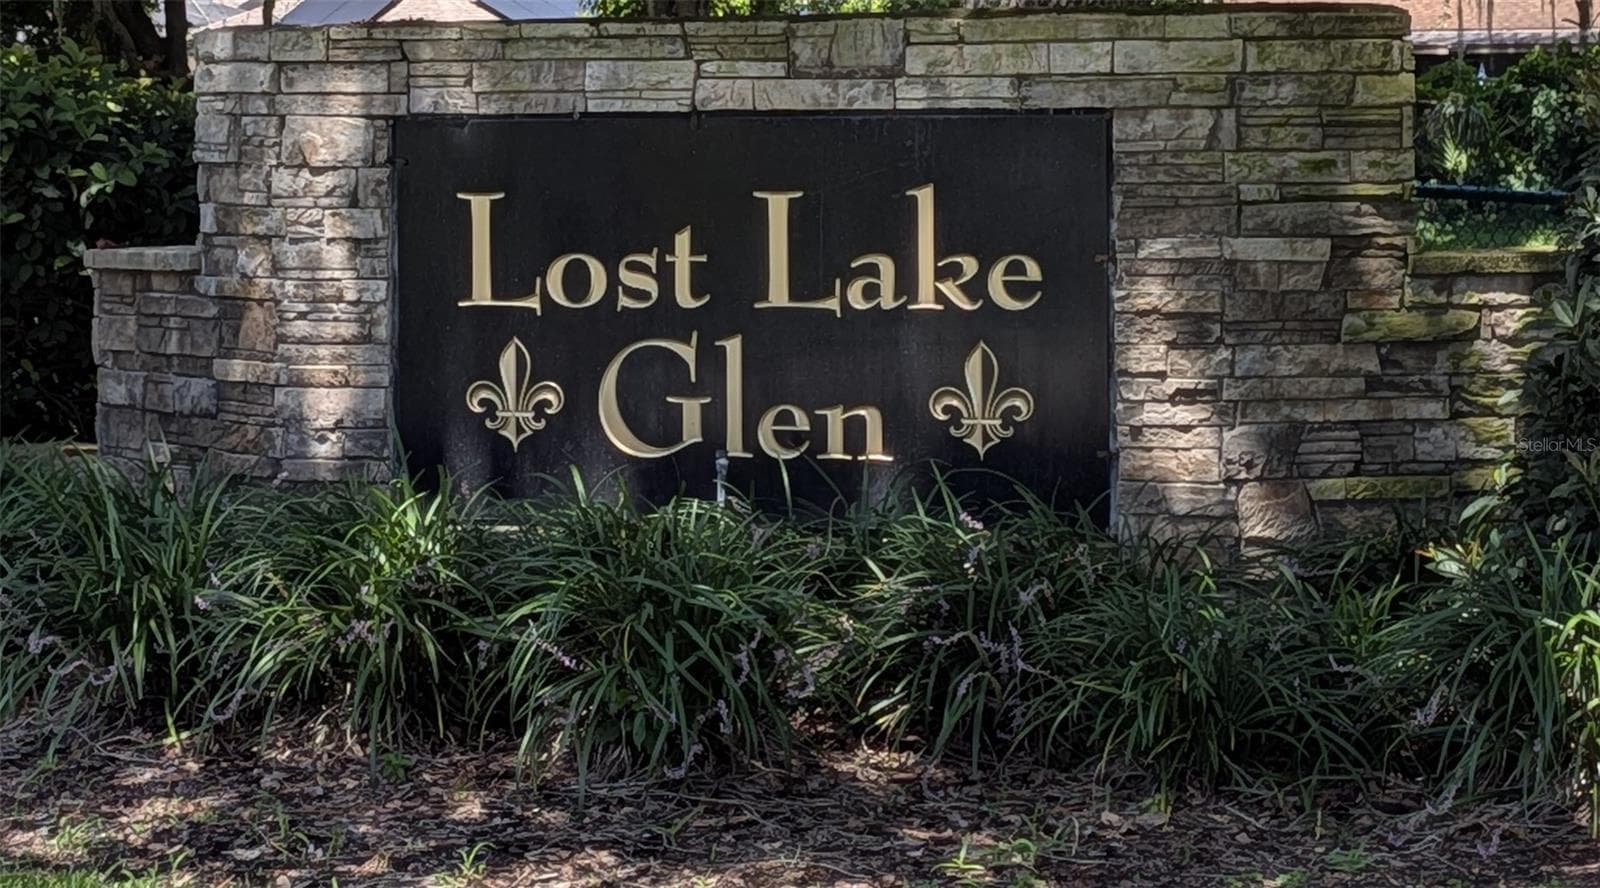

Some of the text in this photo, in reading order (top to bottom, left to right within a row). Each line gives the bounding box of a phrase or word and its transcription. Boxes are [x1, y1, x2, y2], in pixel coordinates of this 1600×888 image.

[456, 183, 1044, 318] Lost Lake
[598, 330, 894, 462] Glen
